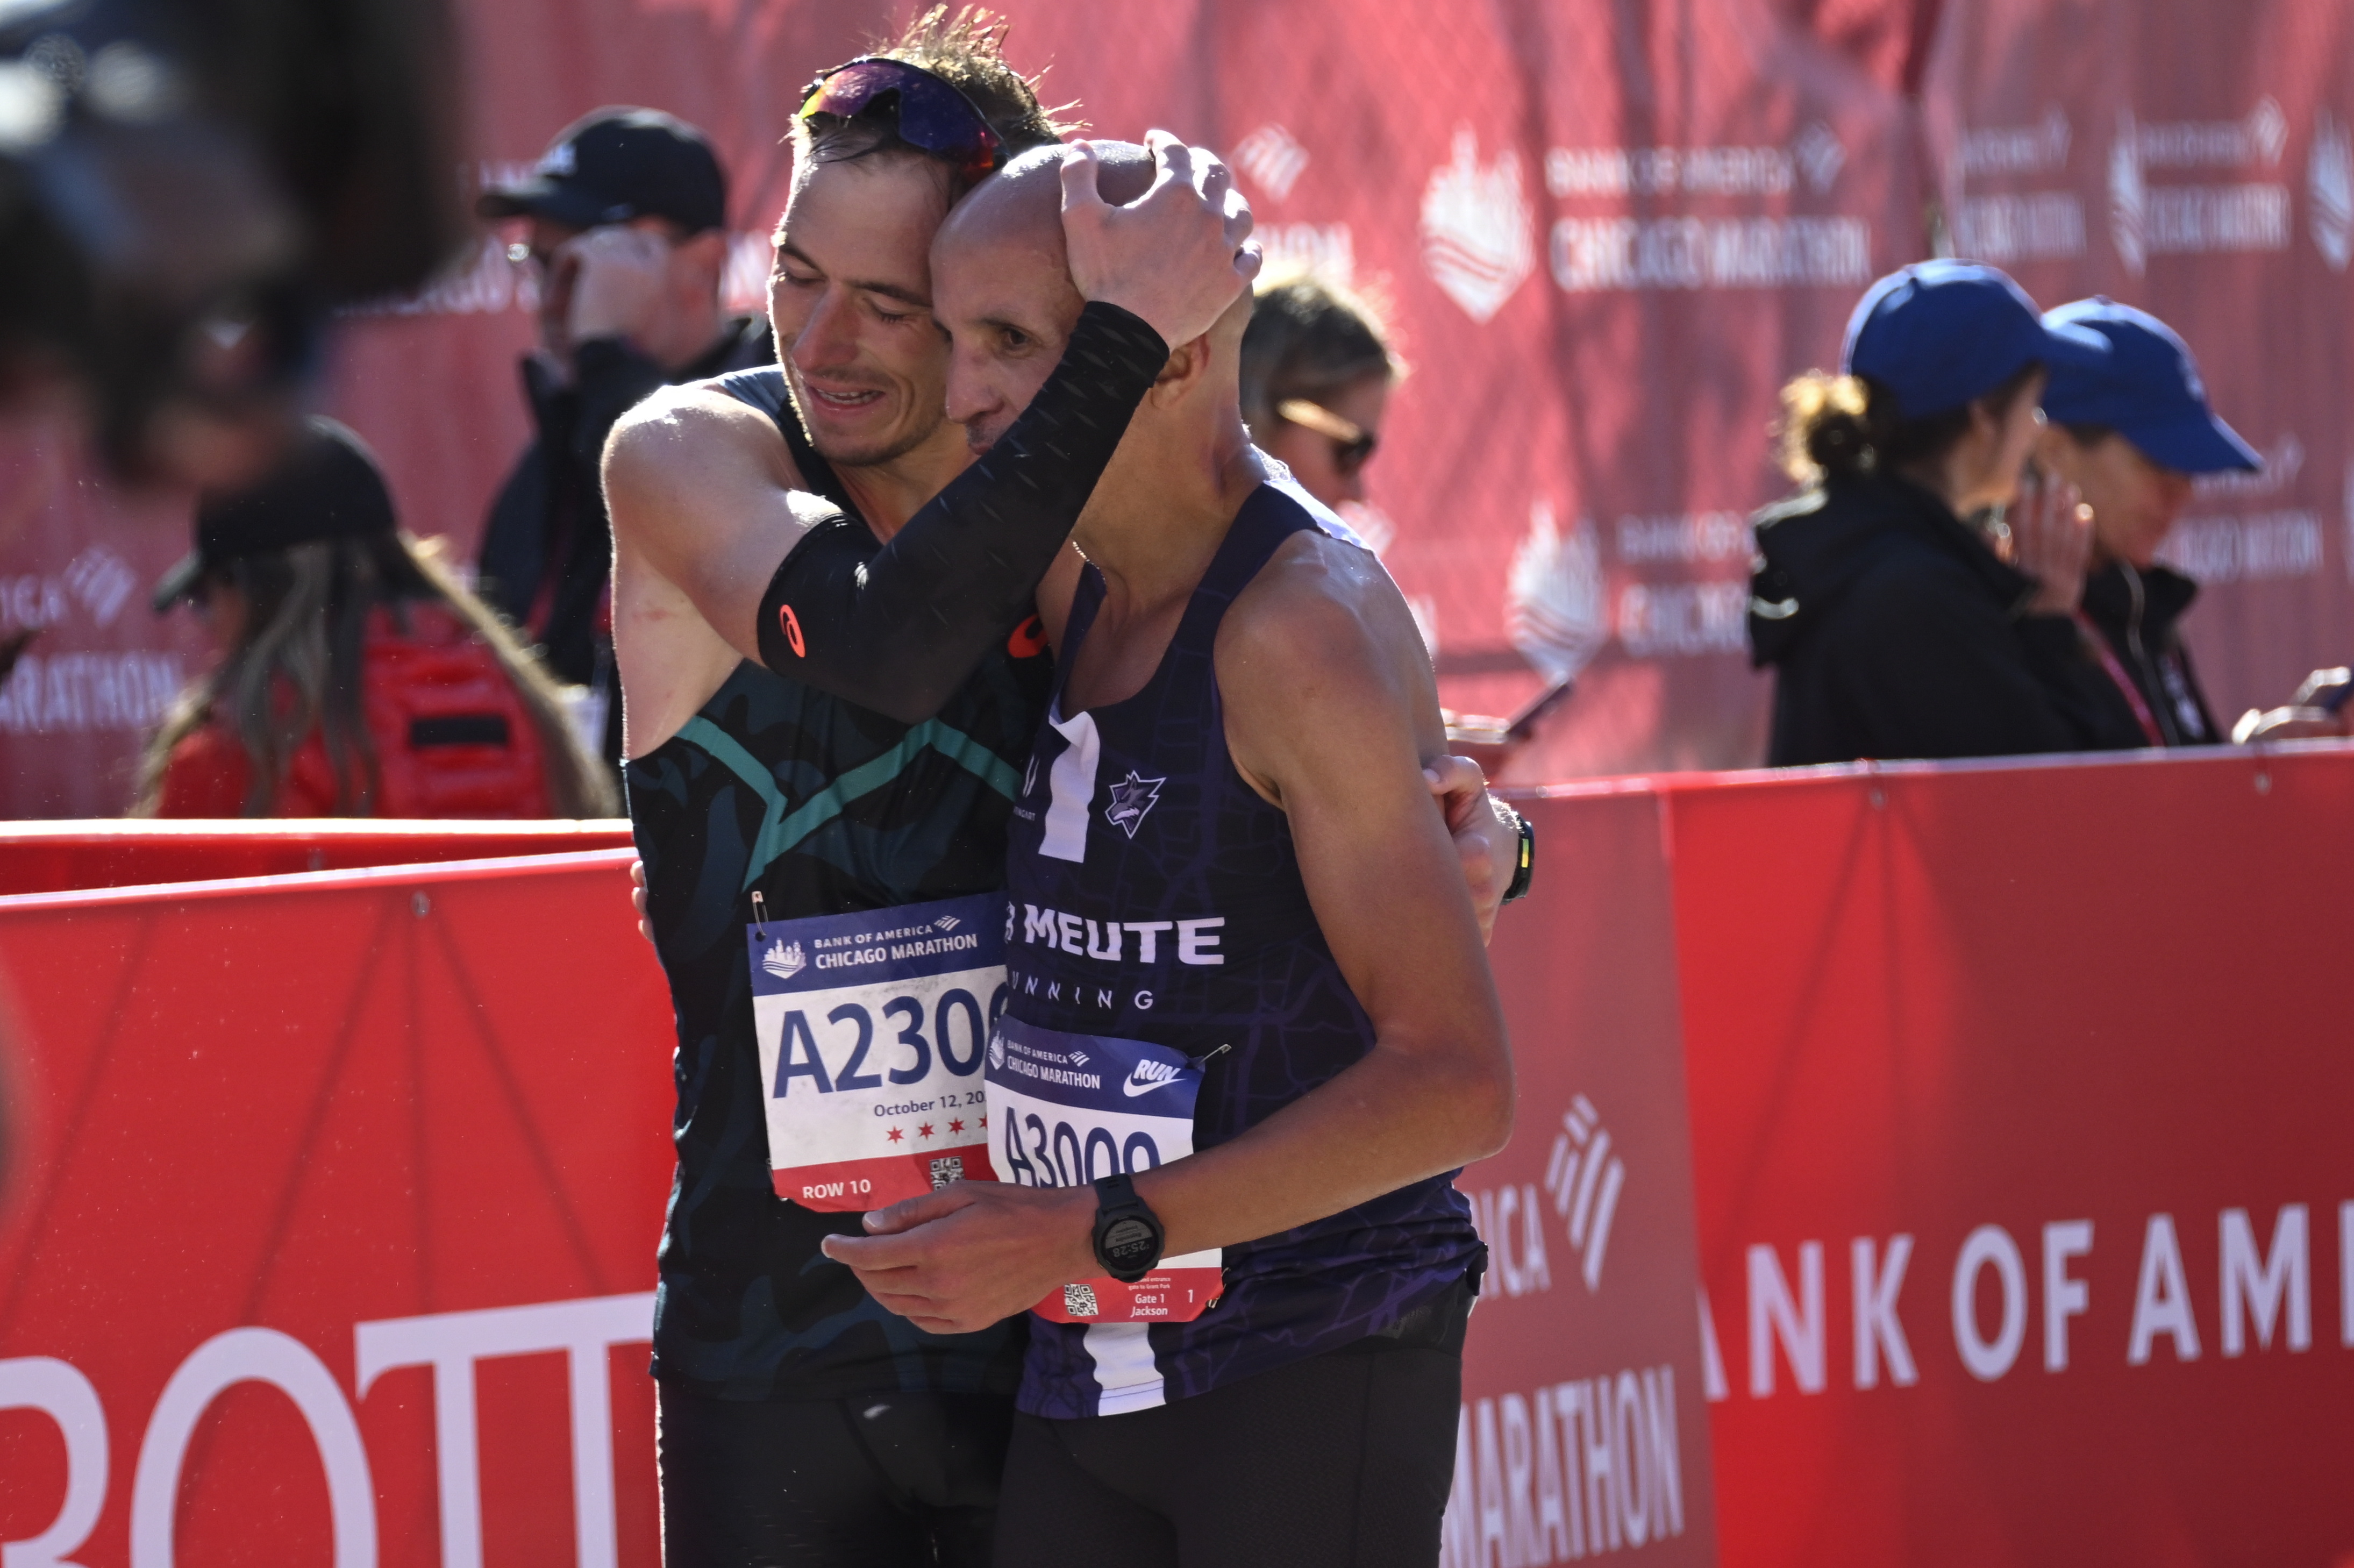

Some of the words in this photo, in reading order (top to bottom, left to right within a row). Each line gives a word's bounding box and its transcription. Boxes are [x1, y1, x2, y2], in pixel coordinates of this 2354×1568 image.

[814, 936, 852, 949] BANK
[854, 933, 872, 944] OF
[875, 925, 933, 942] AMERICA
[1024, 903, 1225, 965] MEUTE
[815, 947, 887, 970] CHICAGO
[890, 933, 978, 960] MARATHON
[1007, 1039, 1023, 1053] BANK
[1032, 1047, 1068, 1064] AMERICA
[1007, 1055, 1039, 1079] CHICAGO
[1040, 1066, 1101, 1090] MARATHON
[1133, 1059, 1181, 1082] RUN
[874, 1099, 935, 1117] October
[939, 1094, 962, 1110] 12,
[966, 1090, 987, 1106] 20
[802, 1181, 844, 1199] ROW
[851, 1179, 871, 1194] 10
[1135, 1294, 1157, 1303] Gate
[1160, 1294, 1165, 1303] 1
[1188, 1289, 1193, 1303] 1
[1951, 1218, 2095, 1383] OF
[1130, 1306, 1168, 1317] Jackson
